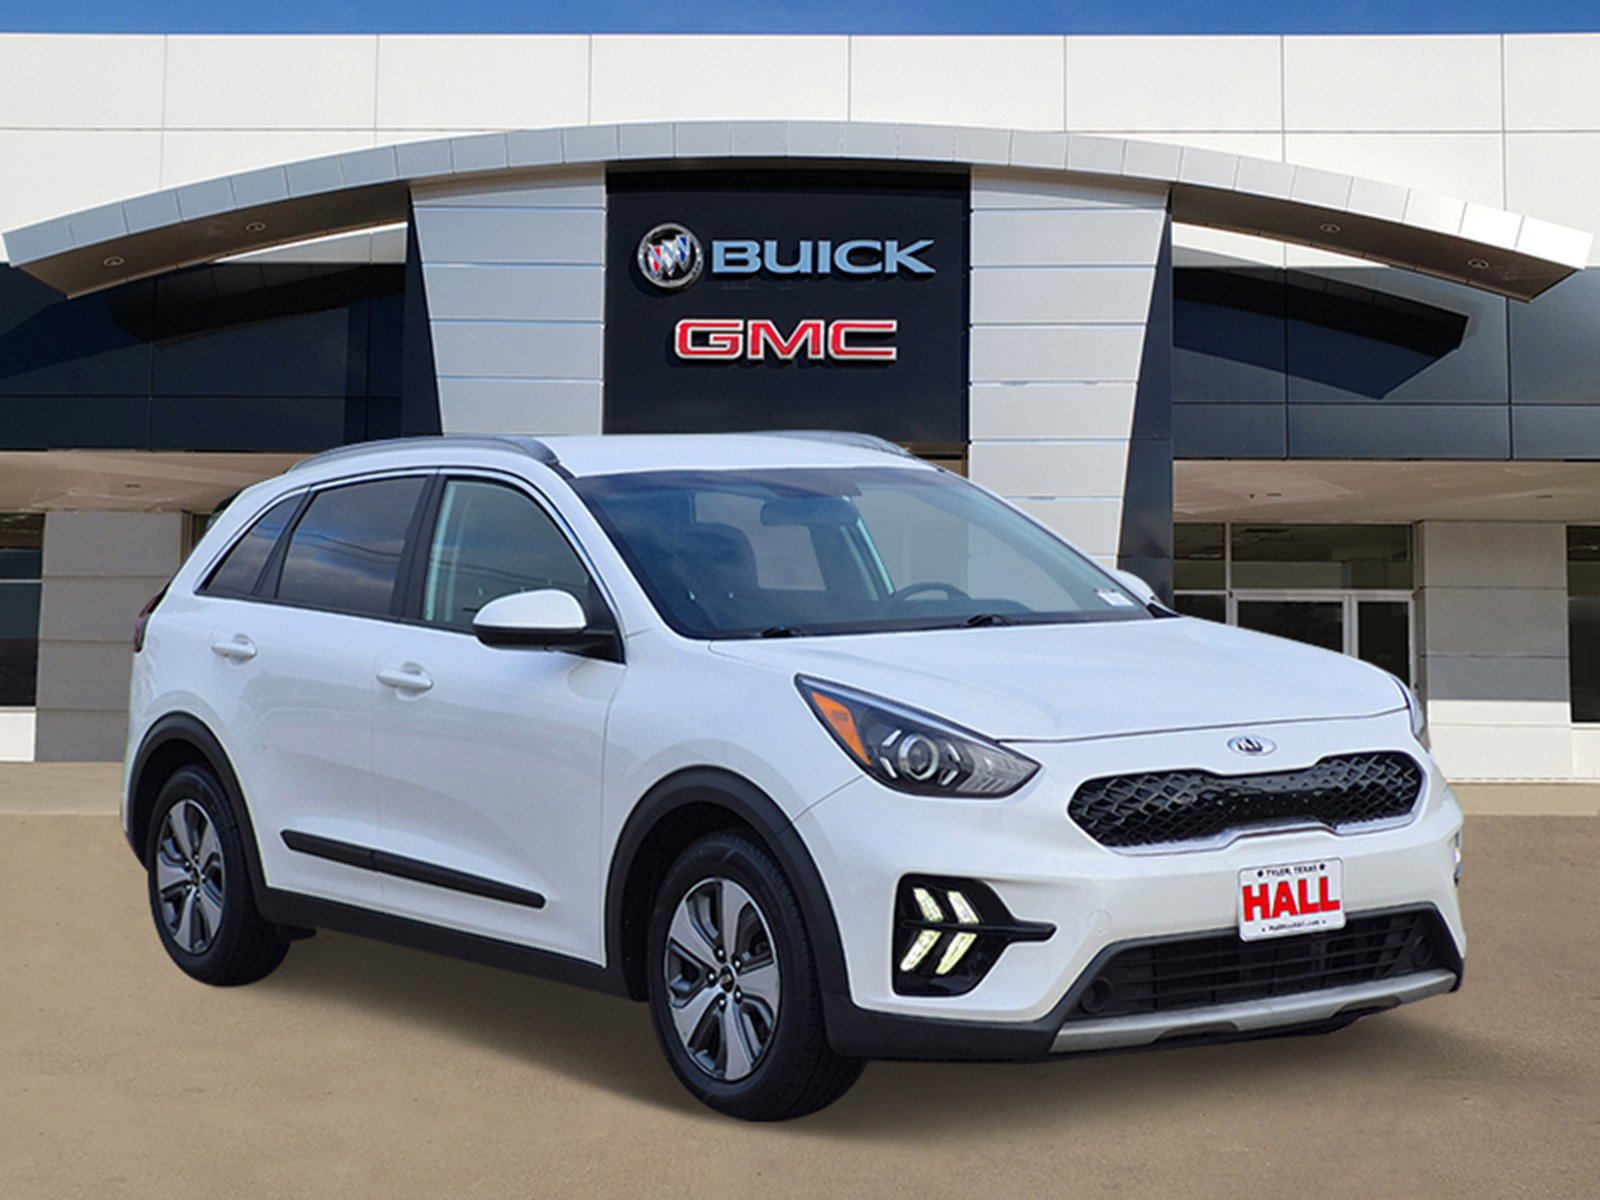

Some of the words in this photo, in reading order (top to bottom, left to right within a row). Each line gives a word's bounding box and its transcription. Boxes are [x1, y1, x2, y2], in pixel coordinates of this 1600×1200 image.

[711, 240, 937, 275] BUICK
[674, 318, 898, 361] GMC
[1242, 876, 1341, 922] HALL
